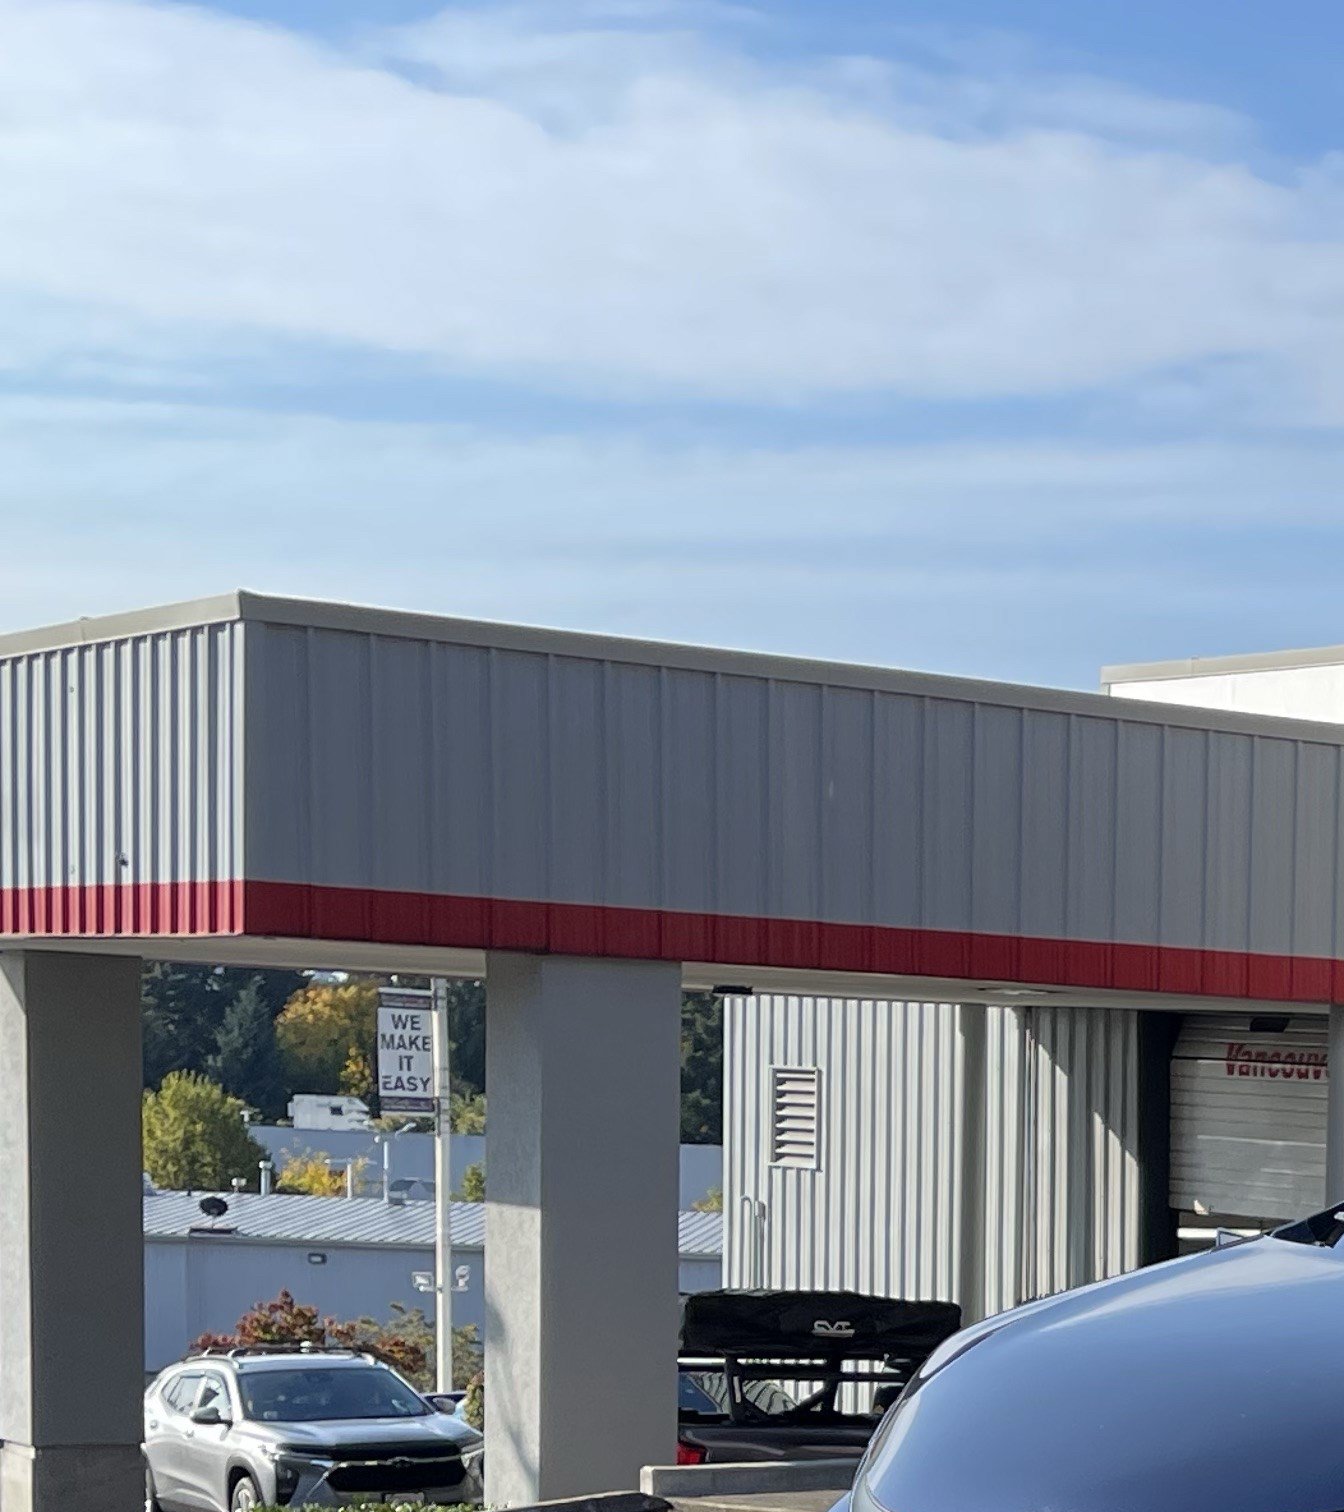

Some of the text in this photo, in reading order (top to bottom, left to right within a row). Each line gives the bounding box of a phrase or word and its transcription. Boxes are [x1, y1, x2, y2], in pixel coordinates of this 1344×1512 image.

[391, 1013, 422, 1031] WE
[380, 1033, 432, 1052] MAKE
[398, 1055, 414, 1072] IT
[1226, 1042, 1329, 1080] Vancouv
[381, 1075, 430, 1092] EASY
